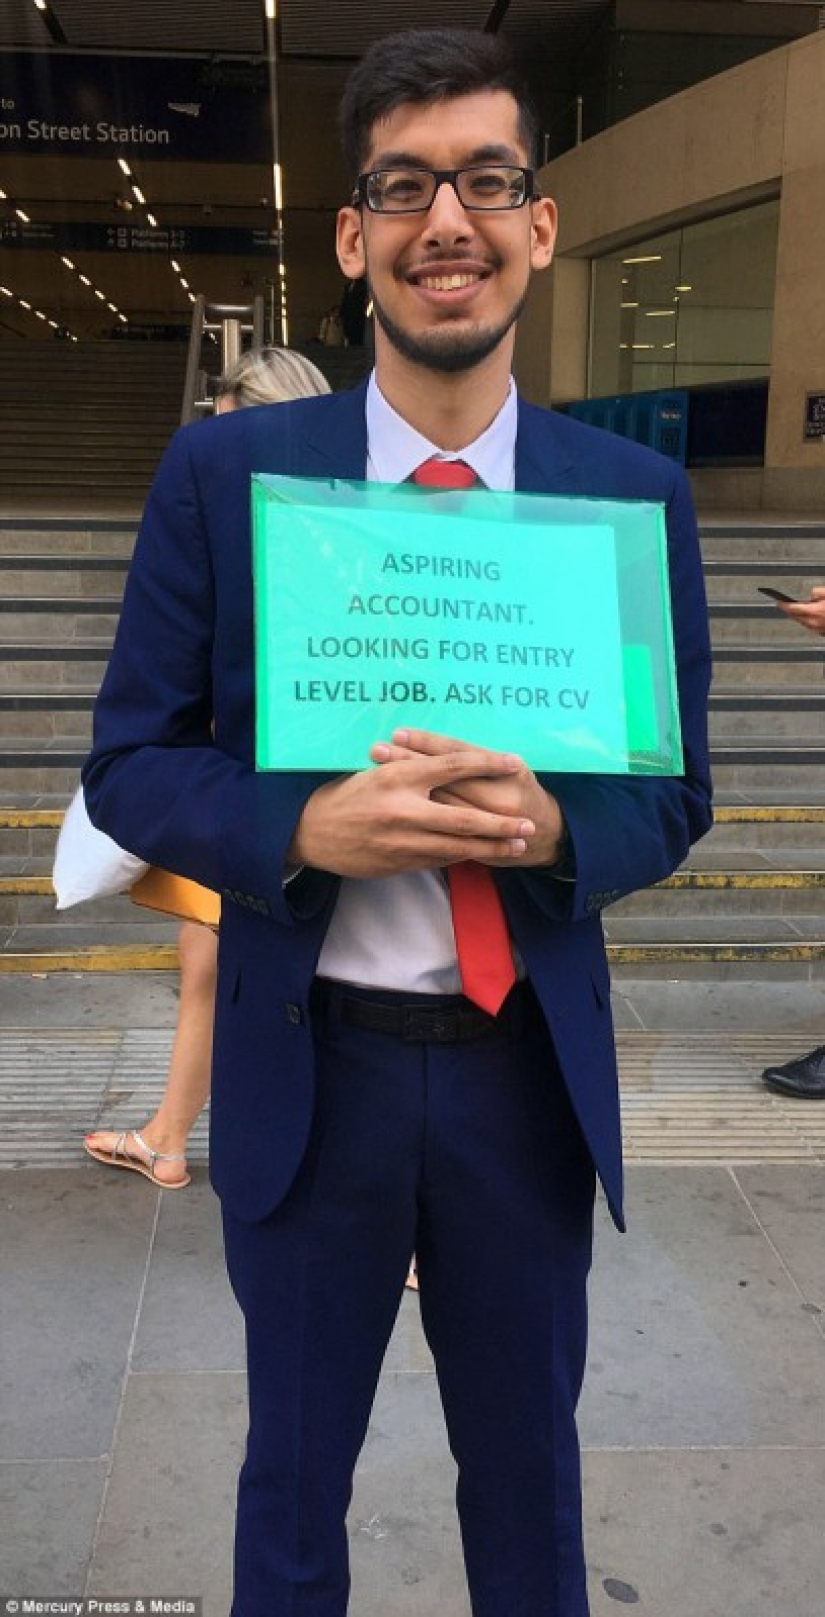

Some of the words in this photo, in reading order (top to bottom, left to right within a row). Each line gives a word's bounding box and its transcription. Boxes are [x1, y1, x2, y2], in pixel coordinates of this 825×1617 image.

[27, 120, 91, 141] Street
[96, 122, 170, 144] Station
[381, 552, 501, 581] ASPIRING
[347, 594, 535, 625] ACCOUNTANT.
[307, 636, 430, 660] LOOKING
[439, 640, 488, 664] FOR
[496, 644, 575, 668] ENTRY
[294, 680, 371, 702] LEVEL
[379, 681, 436, 704] JOB.
[445, 683, 494, 706] ASK
[501, 686, 549, 708] FOR
[557, 689, 590, 710] CV
